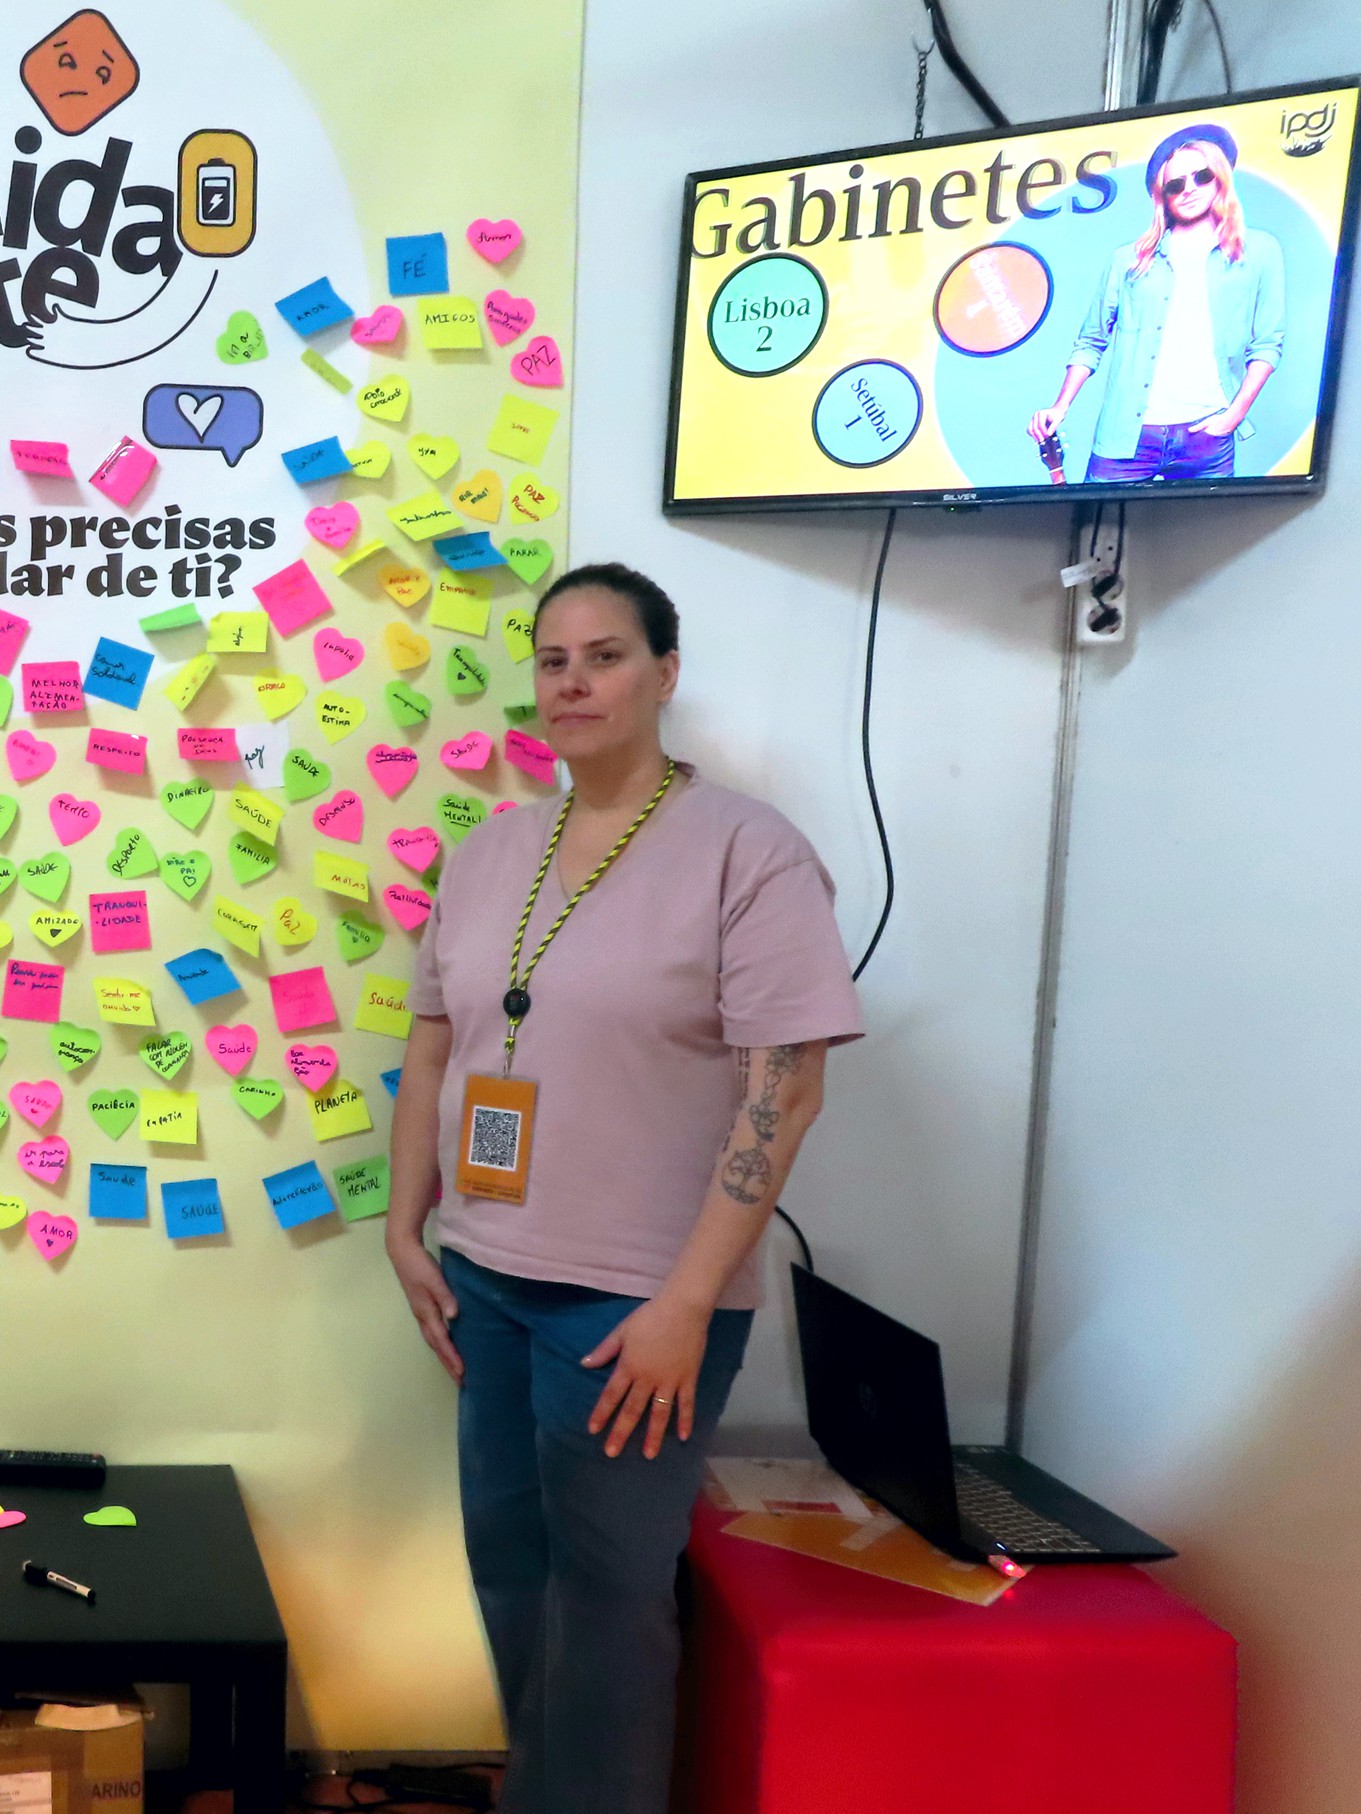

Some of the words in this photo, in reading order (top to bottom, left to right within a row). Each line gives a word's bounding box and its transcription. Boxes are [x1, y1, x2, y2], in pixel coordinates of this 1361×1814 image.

[691, 148, 1119, 260] Gabinetes
[403, 253, 428, 278] FÉ
[425, 312, 476, 325] AMIGOS
[724, 294, 811, 325] Lisboa
[755, 325, 773, 353] 2
[521, 344, 556, 376] PAZ
[844, 415, 862, 431] 1
[850, 377, 898, 442] Setúbal
[29, 504, 277, 561] precisas
[86, 552, 158, 598] de
[168, 552, 242, 599] ti?
[31, 679, 79, 688] MELHOR
[235, 798, 272, 828] SAÚDE
[369, 992, 407, 1012] Saúd
[315, 1091, 358, 1114] PLANETA
[40, 1224, 73, 1240] AMOR
